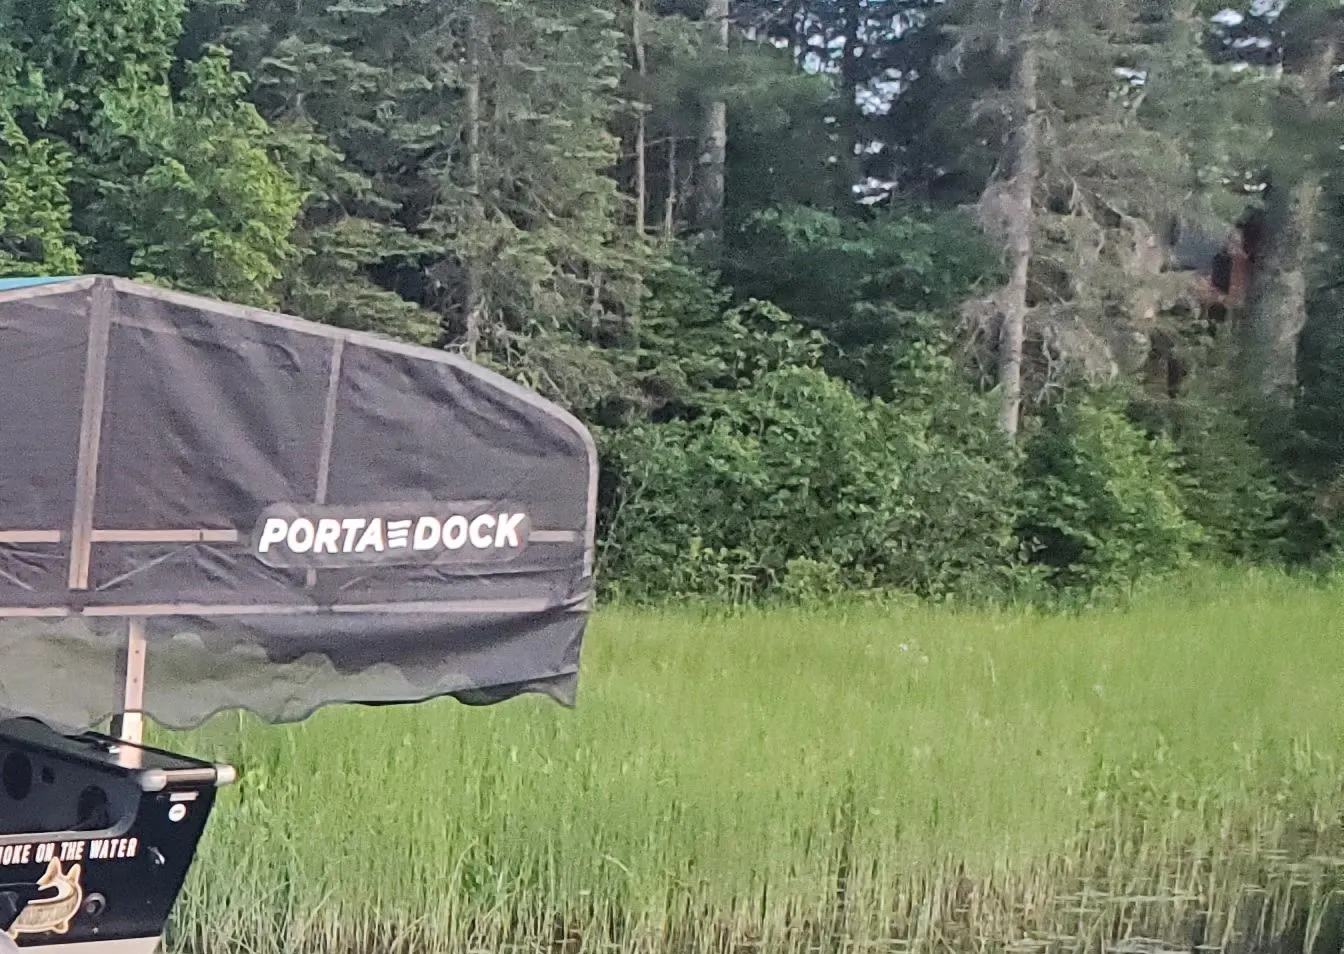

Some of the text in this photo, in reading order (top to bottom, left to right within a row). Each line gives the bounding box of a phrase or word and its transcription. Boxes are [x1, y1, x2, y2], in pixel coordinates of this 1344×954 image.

[258, 512, 527, 553] PORTA DOCK
[35, 842, 55, 863] ON
[60, 841, 85, 861] THE
[89, 838, 138, 859] WATER
